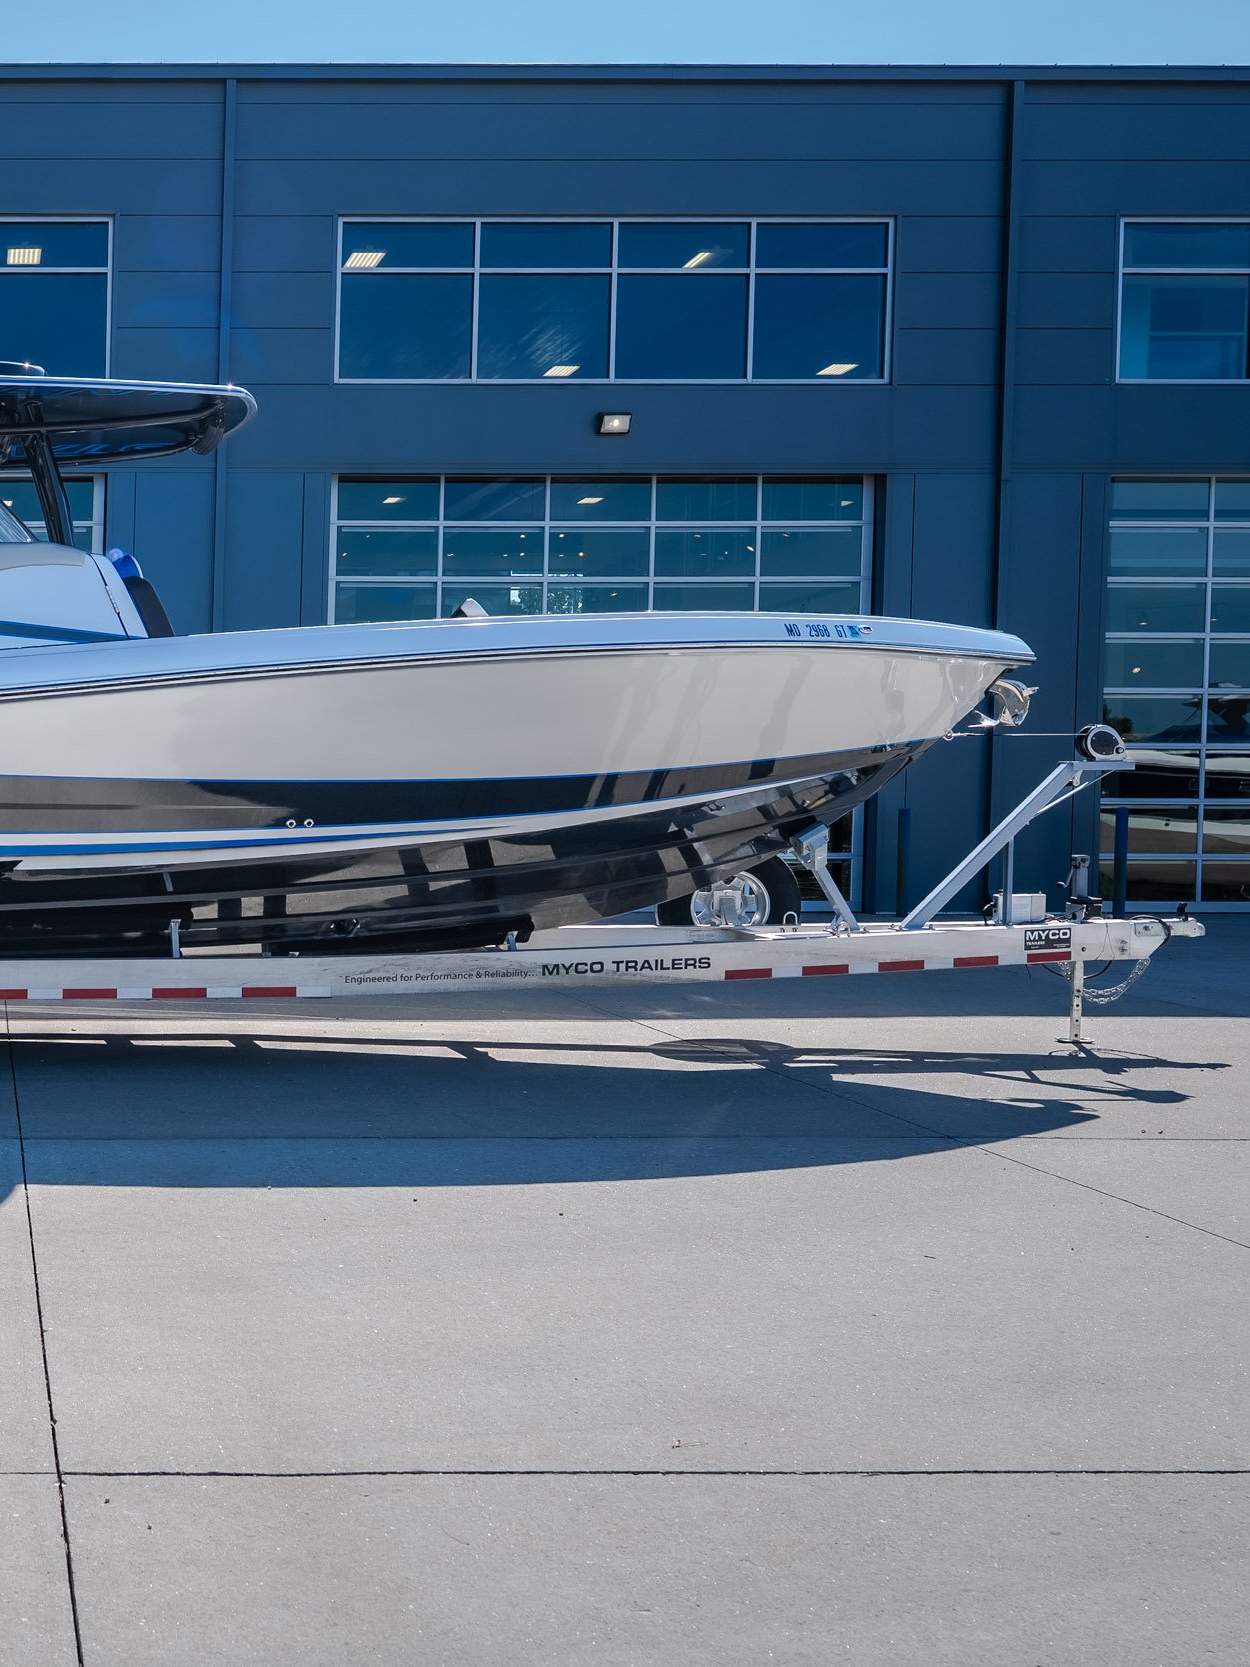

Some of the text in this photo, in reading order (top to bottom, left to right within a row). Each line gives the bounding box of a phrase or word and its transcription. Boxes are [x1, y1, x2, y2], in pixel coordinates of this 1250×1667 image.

[784, 623, 801, 637] MO
[806, 623, 831, 638] 2968
[834, 624, 848, 639] GT
[1026, 929, 1070, 940] MYCO
[541, 956, 712, 977] MYCO TRAILERS
[344, 974, 398, 985] Engineered
[400, 974, 413, 982] for
[415, 971, 473, 982] Performance
[475, 970, 483, 979] &
